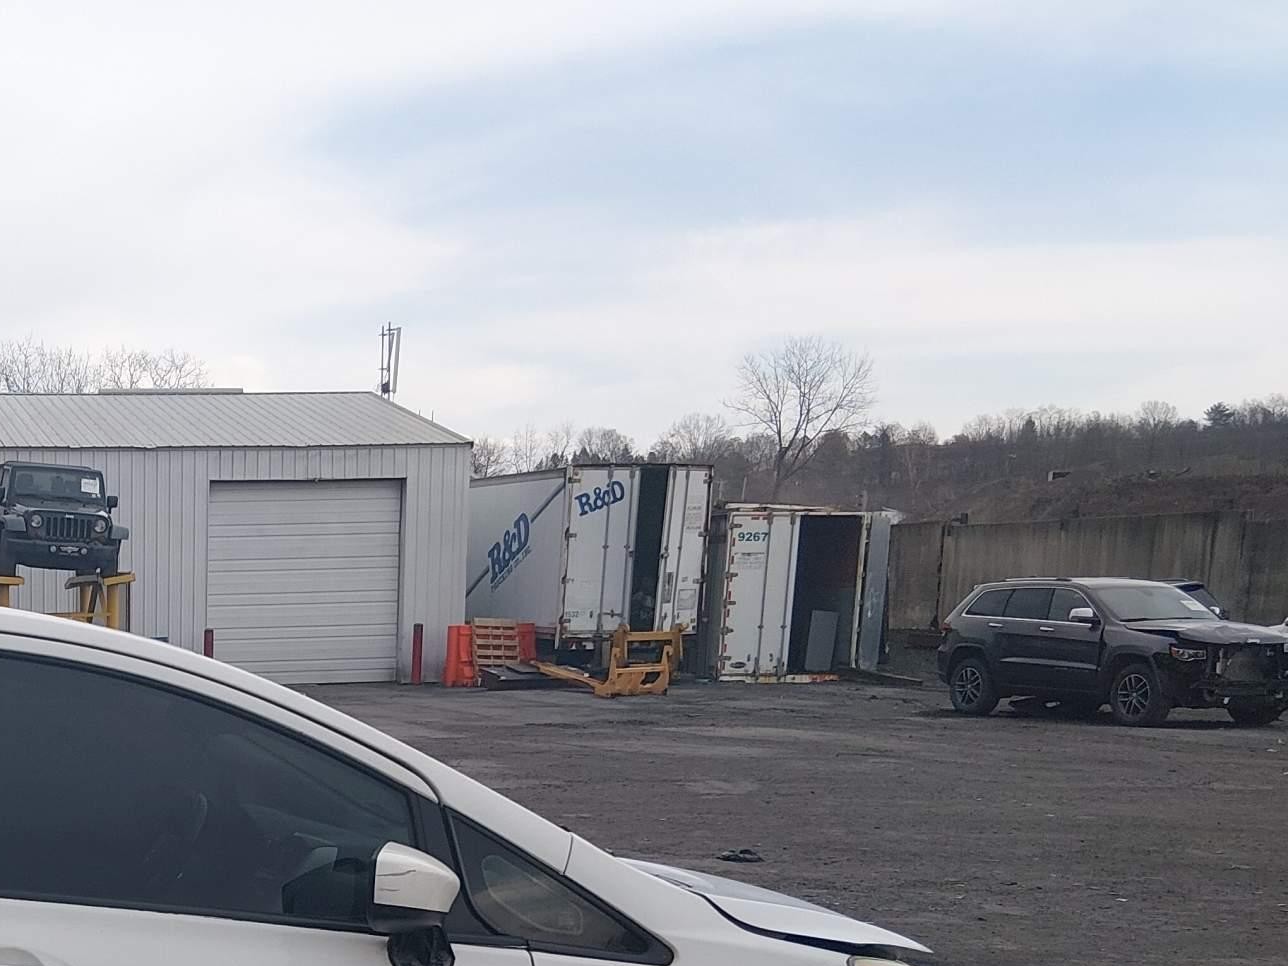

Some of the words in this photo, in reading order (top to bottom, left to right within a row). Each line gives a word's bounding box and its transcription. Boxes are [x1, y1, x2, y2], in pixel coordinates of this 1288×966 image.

[574, 480, 625, 516] R&D
[488, 512, 530, 584] R&D
[737, 532, 769, 542] 9267
